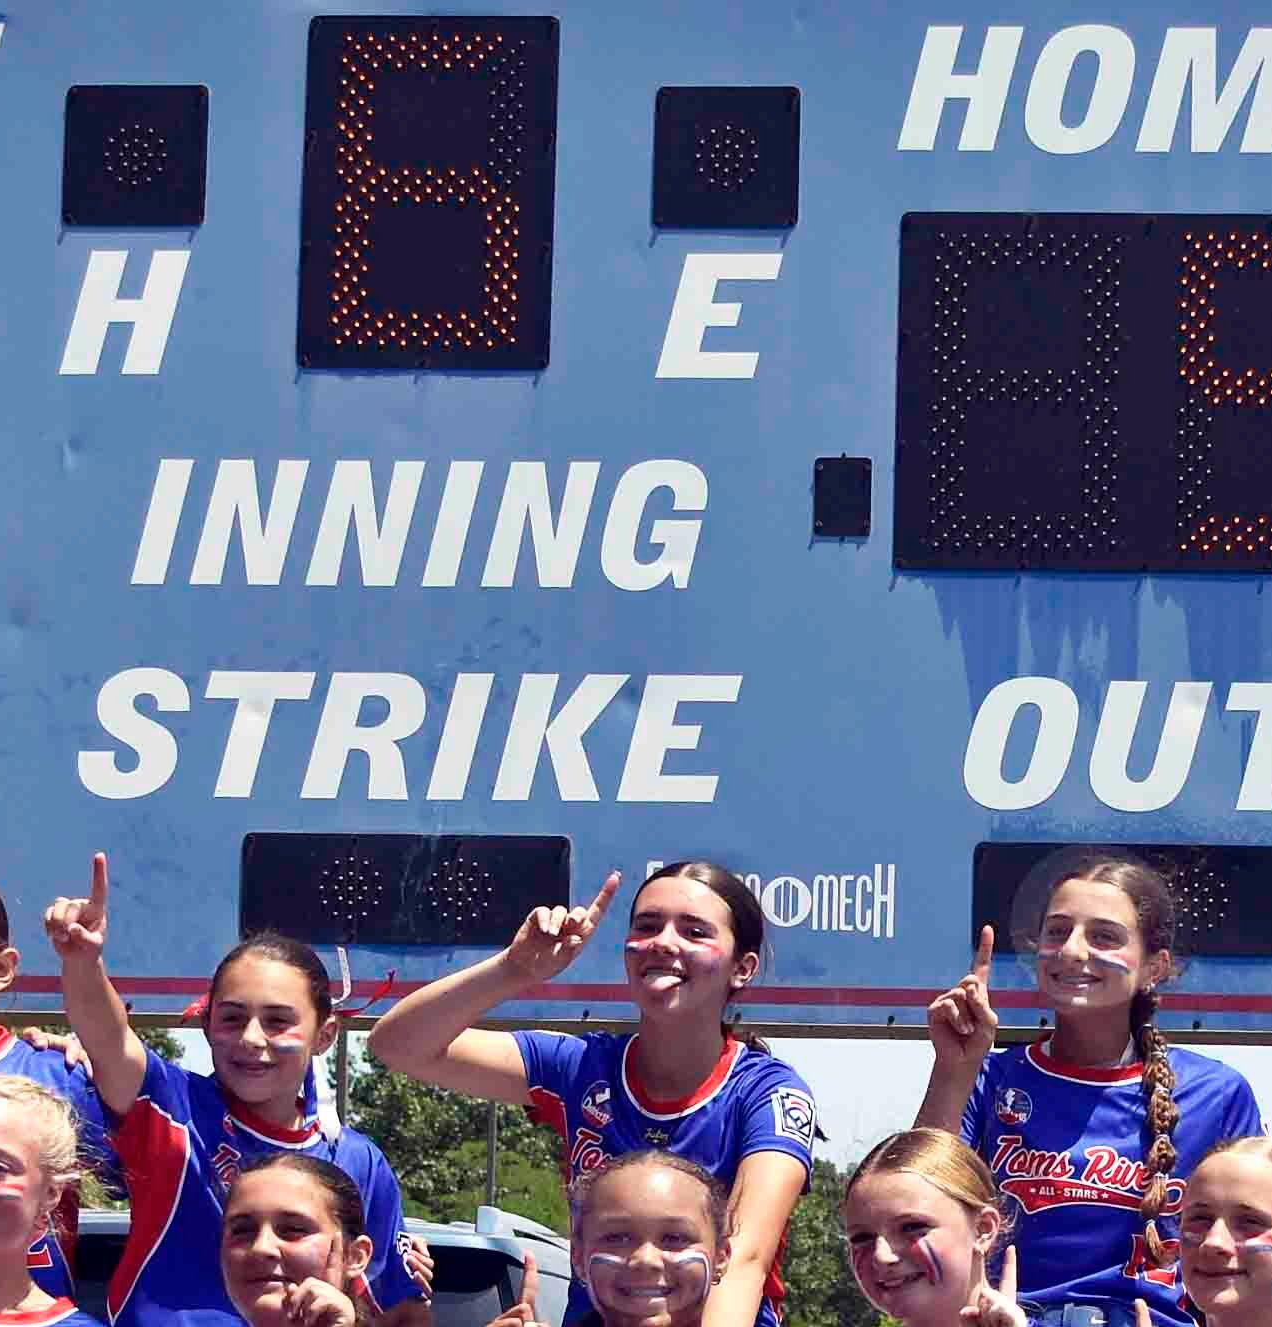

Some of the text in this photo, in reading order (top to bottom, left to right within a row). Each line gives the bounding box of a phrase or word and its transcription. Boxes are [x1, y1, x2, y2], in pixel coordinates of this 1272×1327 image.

[329, 31, 524, 349] 6
[58, 250, 191, 375] H
[654, 253, 784, 379] E
[131, 459, 708, 591] INNING
[77, 667, 743, 803] STRIKE
[991, 1135, 1073, 1179] Toms
